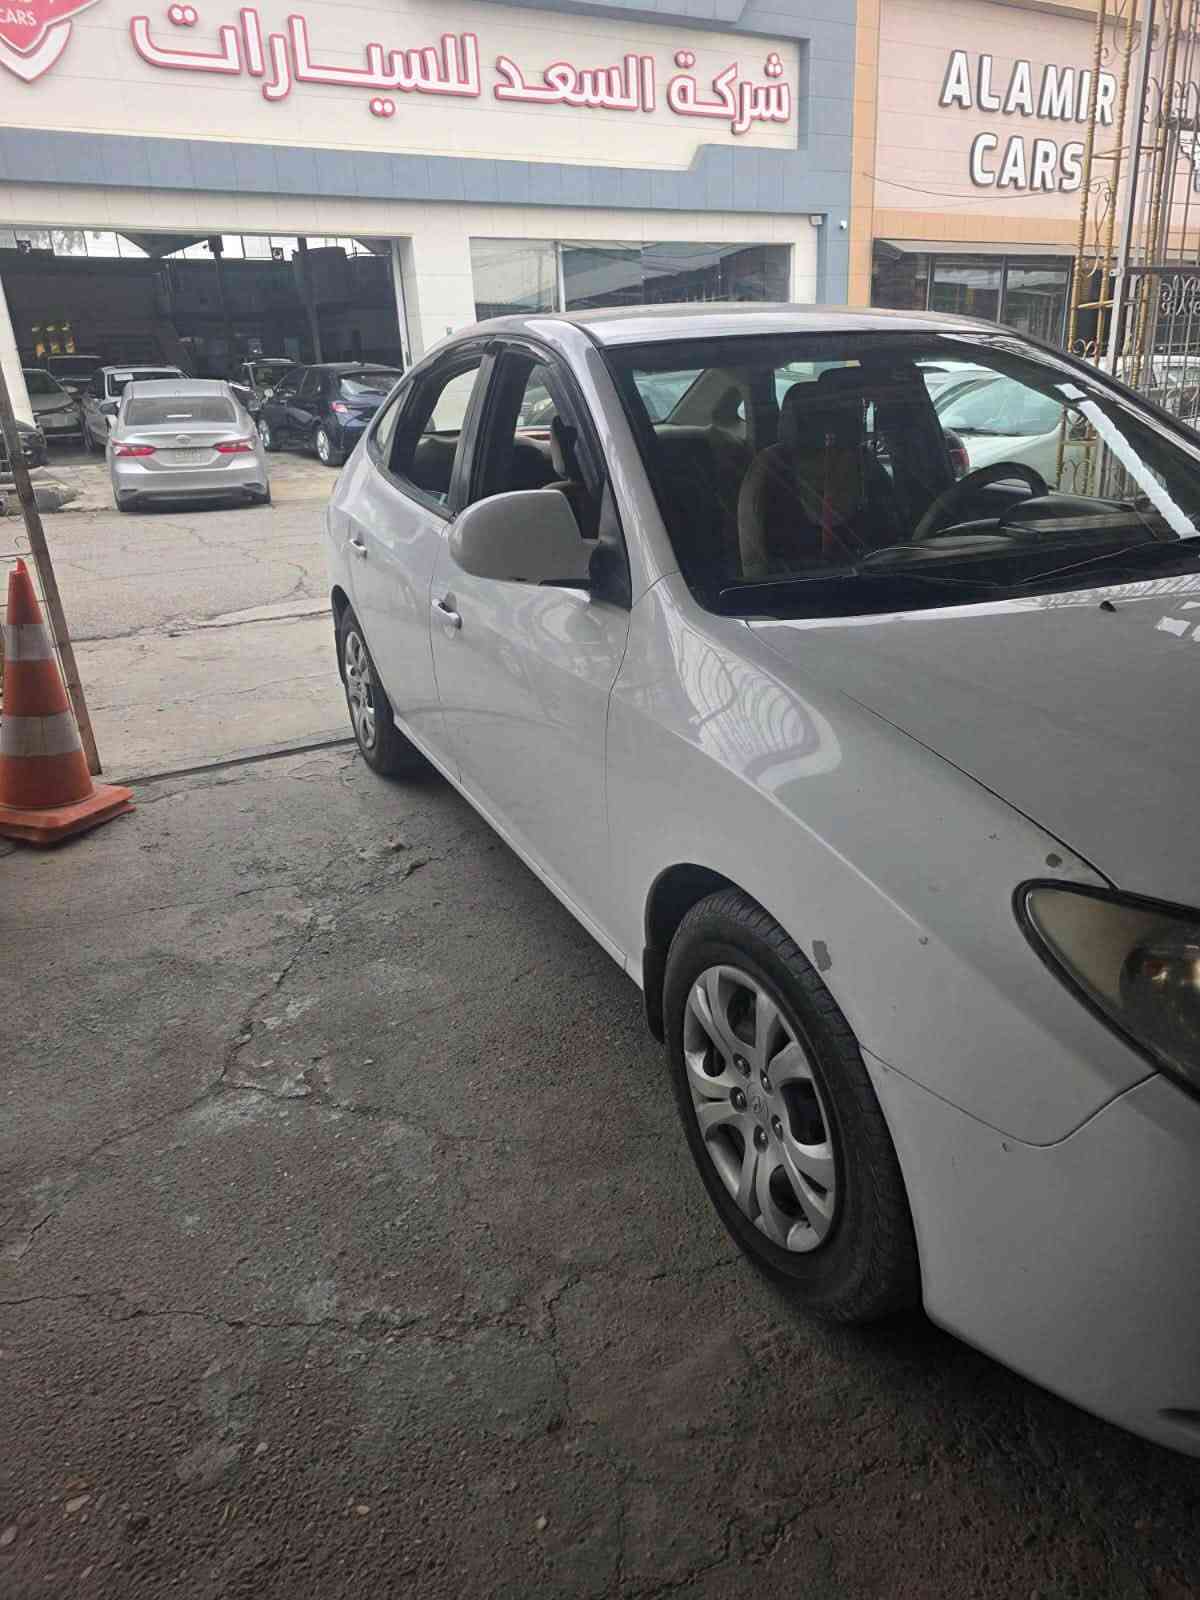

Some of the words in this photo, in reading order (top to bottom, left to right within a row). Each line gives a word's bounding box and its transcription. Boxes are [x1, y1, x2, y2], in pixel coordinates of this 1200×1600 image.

[130, 5, 481, 118] للسيارات
[495, 54, 656, 112] السعد
[668, 51, 791, 135] شركة
[939, 50, 1117, 126] ALAMIR
[969, 132, 1085, 192] CARS
